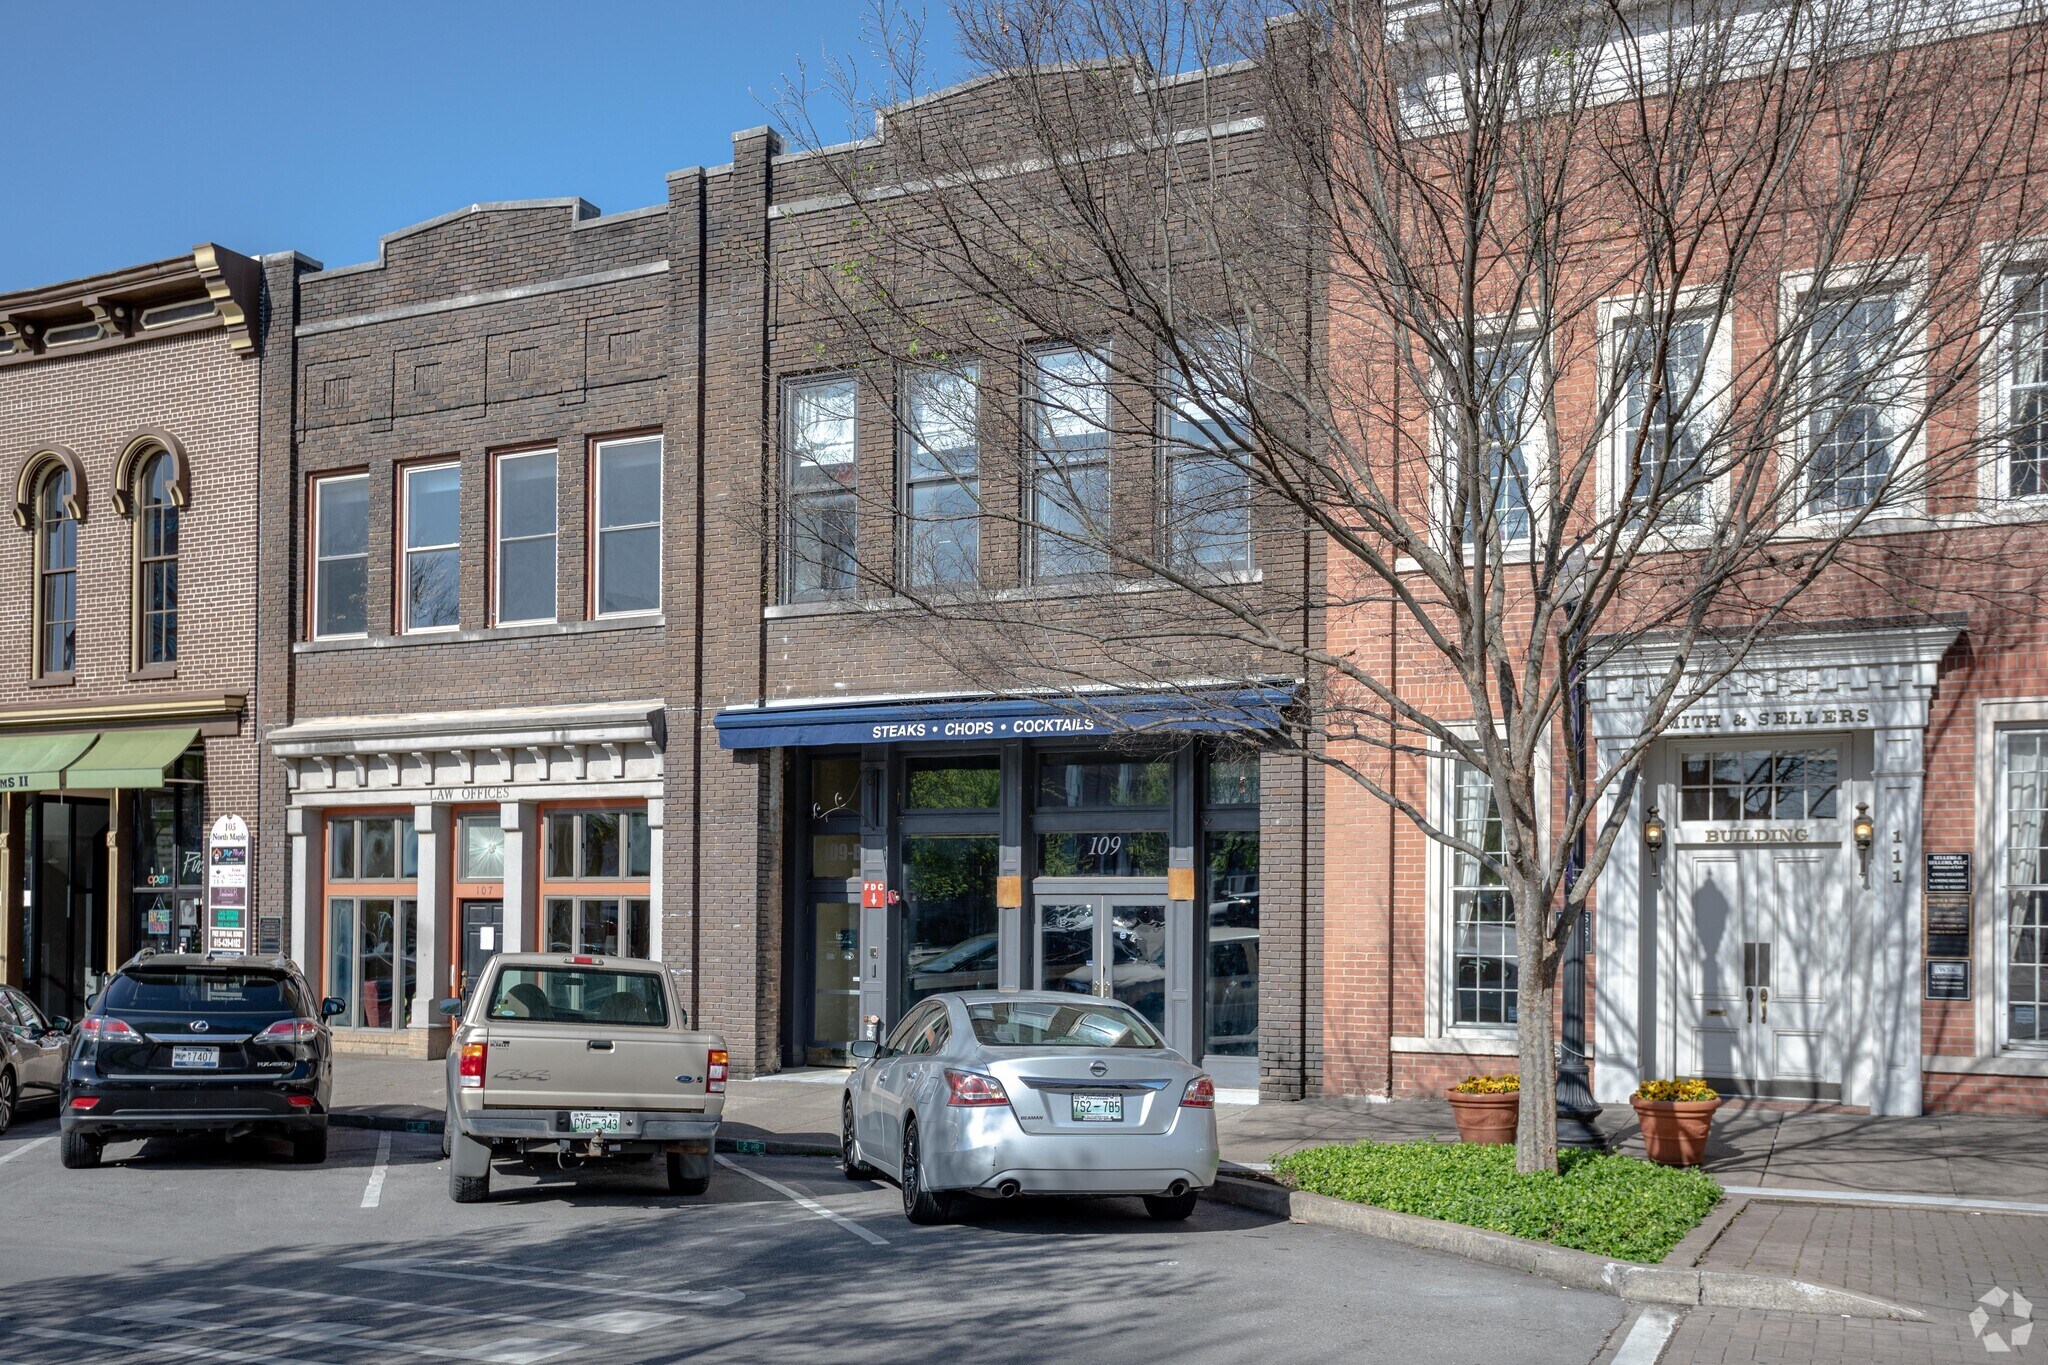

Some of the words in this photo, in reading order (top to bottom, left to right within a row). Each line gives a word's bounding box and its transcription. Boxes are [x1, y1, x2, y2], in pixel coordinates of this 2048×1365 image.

[1733, 714, 1746, 727] &
[1758, 708, 1869, 726] SELLERS
[872, 724, 926, 738] STEAKS
[944, 722, 994, 736] CHOPS
[1013, 718, 1094, 733] COCKTAILS
[430, 788, 454, 800] LAW
[462, 786, 510, 800] OFFICES
[225, 822, 236, 832] 105
[212, 832, 228, 841] North
[230, 832, 246, 842] Maple
[1705, 828, 1809, 842] BUILDING
[1088, 836, 1122, 856] 109
[148, 874, 168, 886] open
[476, 886, 493, 896] 107
